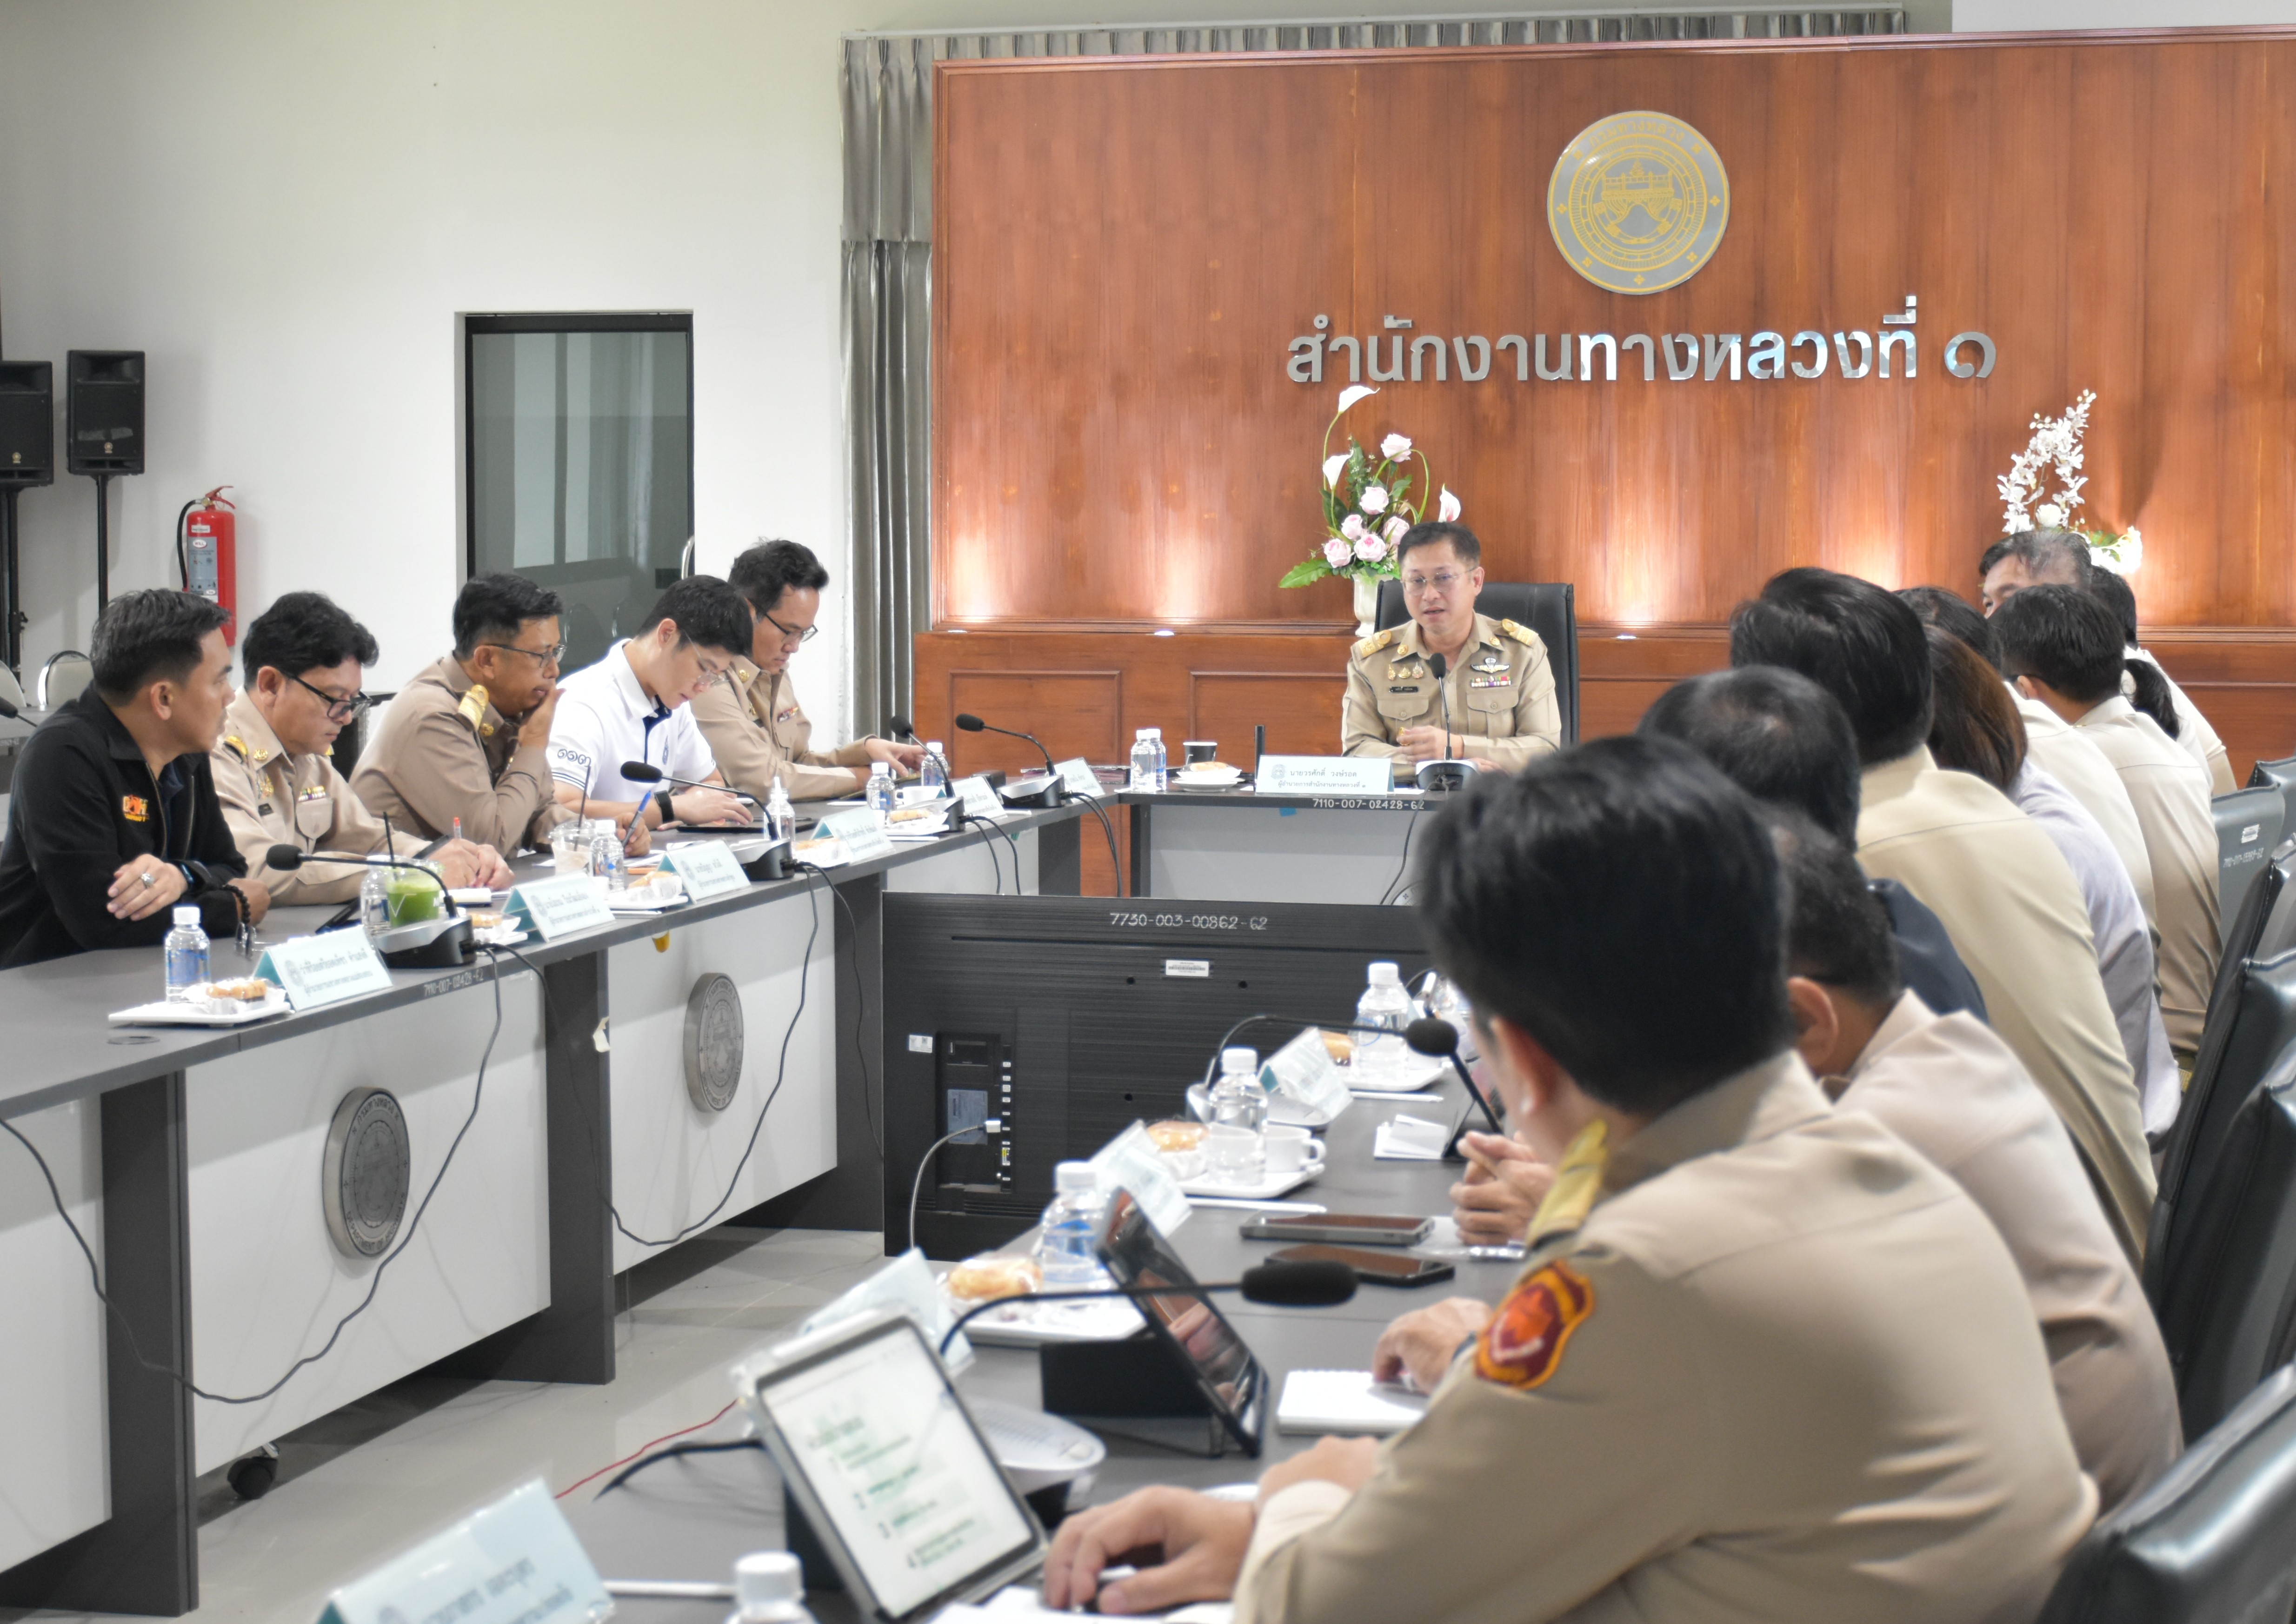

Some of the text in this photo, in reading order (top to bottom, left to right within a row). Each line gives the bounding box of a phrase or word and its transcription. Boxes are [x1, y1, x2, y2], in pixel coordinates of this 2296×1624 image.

[1287, 295, 1997, 382] สำนักงานทางหลวงที่ ๑
[1313, 798, 1424, 810] 7110-007-02428-62
[1110, 913, 1268, 930] 7730-003-00862-62
